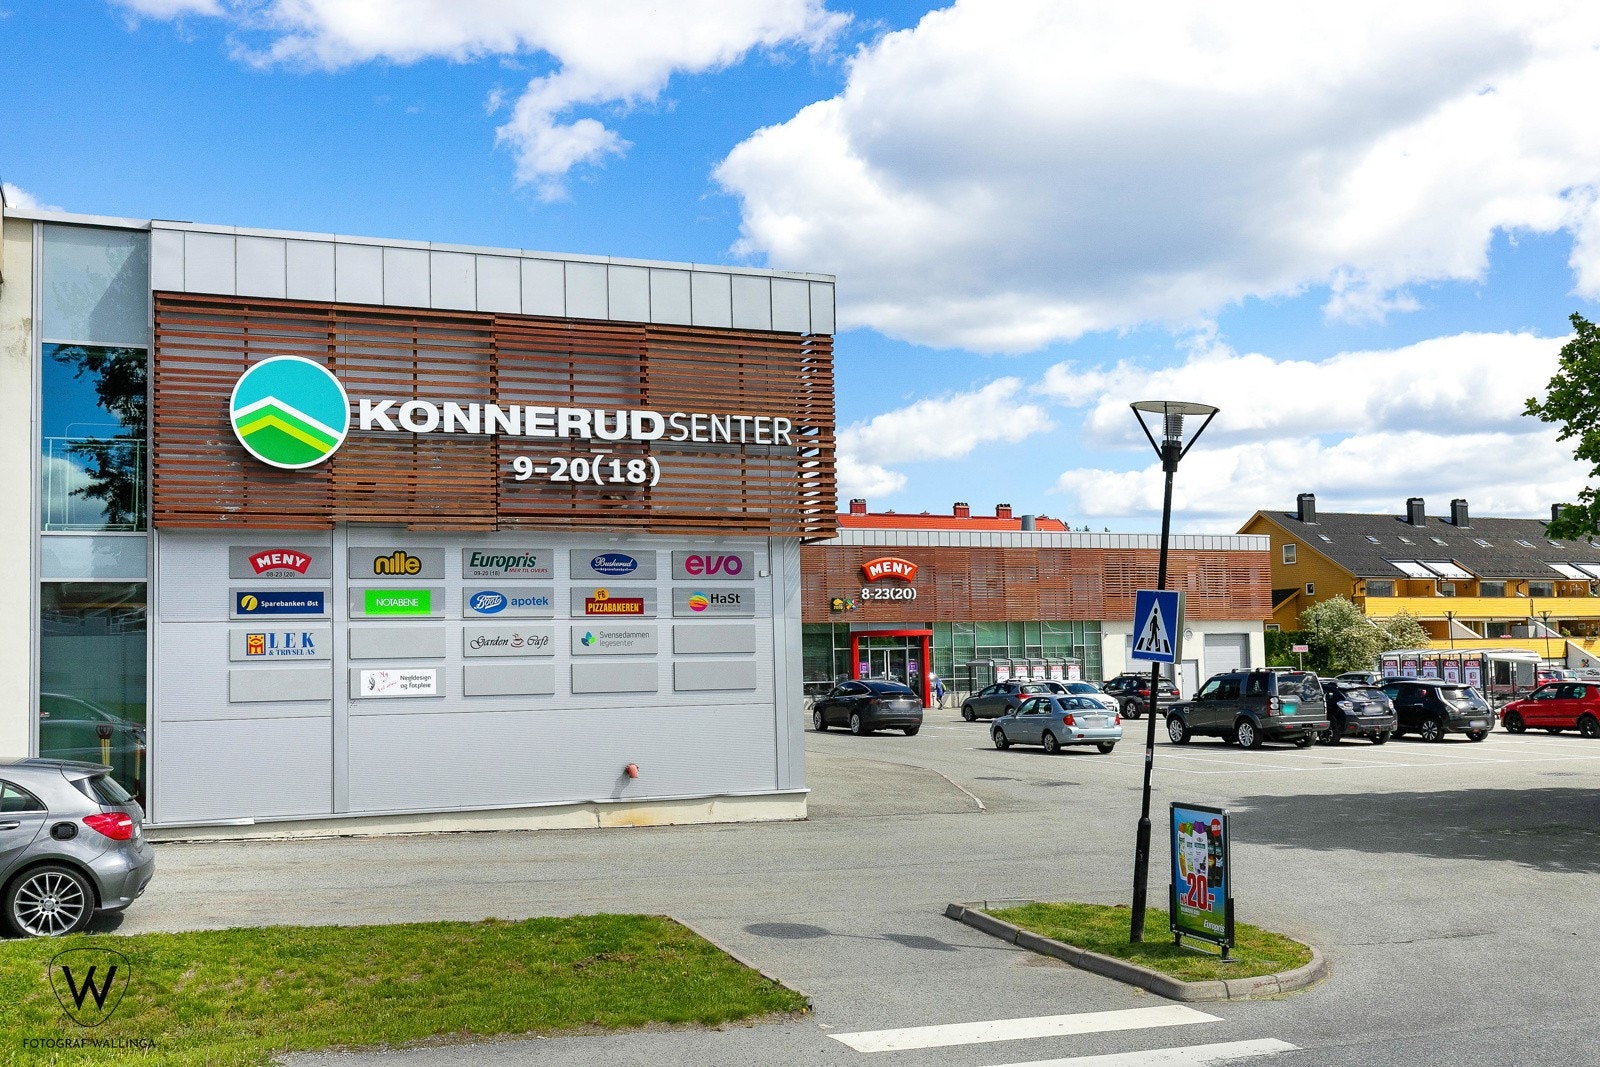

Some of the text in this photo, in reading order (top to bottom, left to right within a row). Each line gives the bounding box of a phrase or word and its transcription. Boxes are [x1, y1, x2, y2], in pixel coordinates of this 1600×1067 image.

[512, 454, 661, 487] 9-20(18)
[256, 553, 306, 568] MENY
[375, 552, 420, 574] nille
[469, 551, 537, 572] Europris
[594, 556, 634, 567] Buskerud
[685, 554, 743, 576] evo
[869, 561, 913, 576] MENY
[710, 593, 741, 604] HaSt
[861, 587, 917, 600] 8-23(20)
[261, 600, 305, 608] Sparebanken
[376, 598, 419, 607] NOTABENE
[511, 596, 549, 607] apotek
[587, 602, 639, 613] PIZZABAKEREN
[599, 630, 650, 638] Svensedammen
[469, 635, 509, 649] Garden
[599, 640, 634, 648] legesenter
[1203, 919, 1225, 933] Europris
